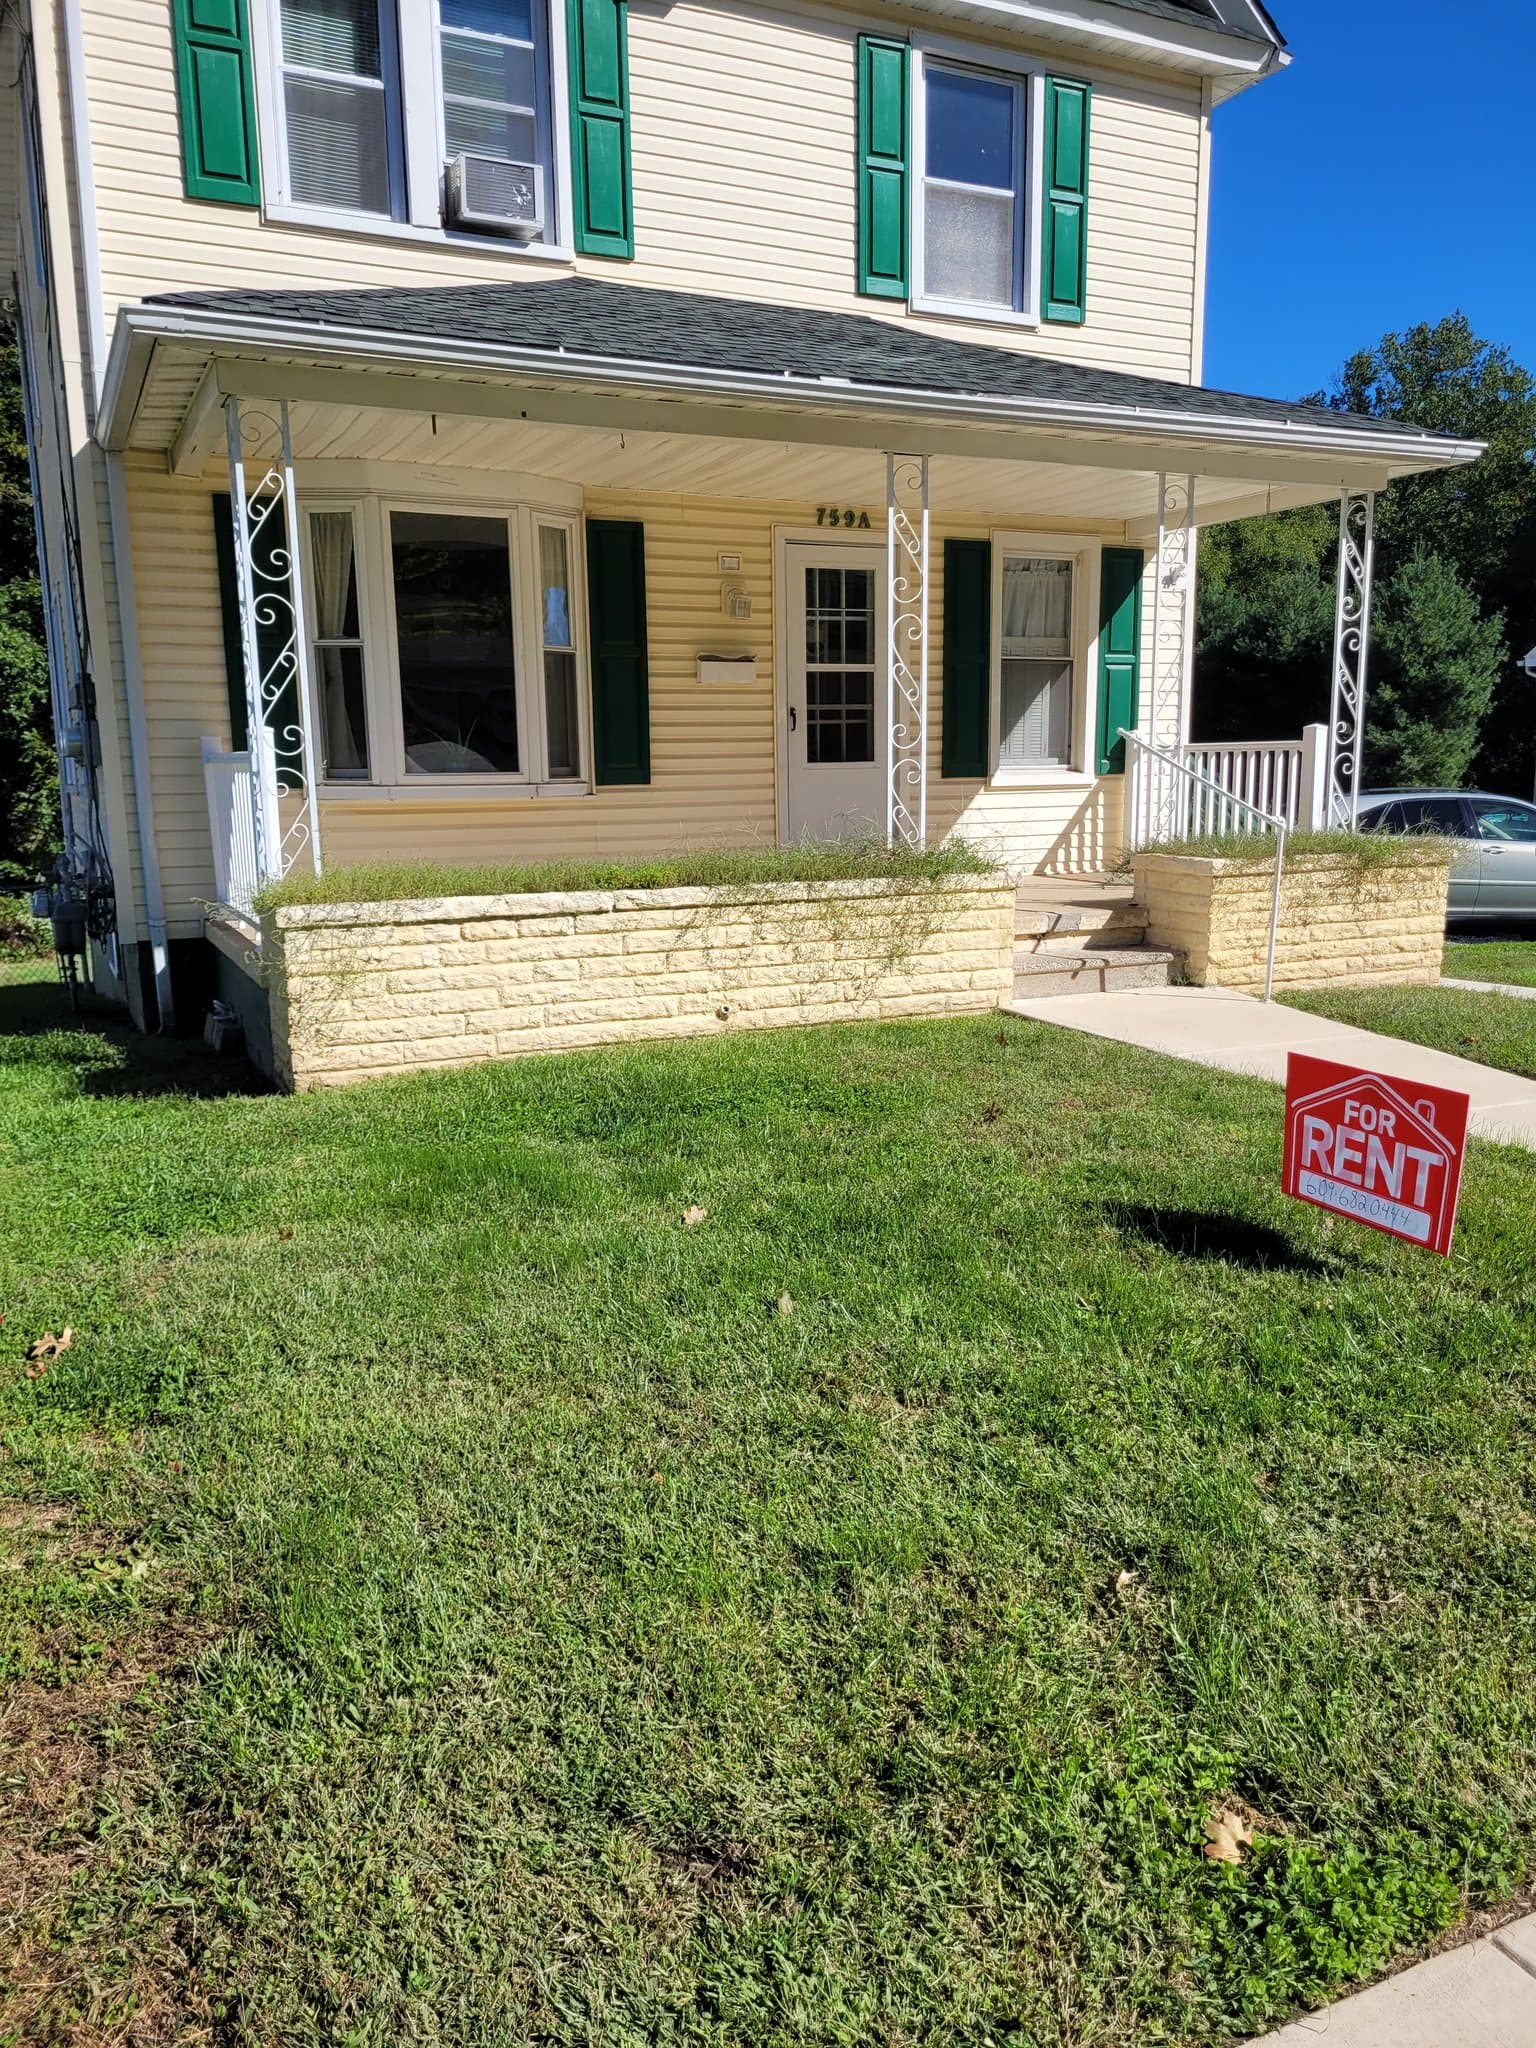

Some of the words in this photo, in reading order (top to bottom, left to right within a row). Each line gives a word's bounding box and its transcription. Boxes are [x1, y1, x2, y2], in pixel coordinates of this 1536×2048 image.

[816, 507, 871, 528] 759A
[1344, 1099, 1396, 1138] FOR
[1301, 1114, 1444, 1207] RENT
